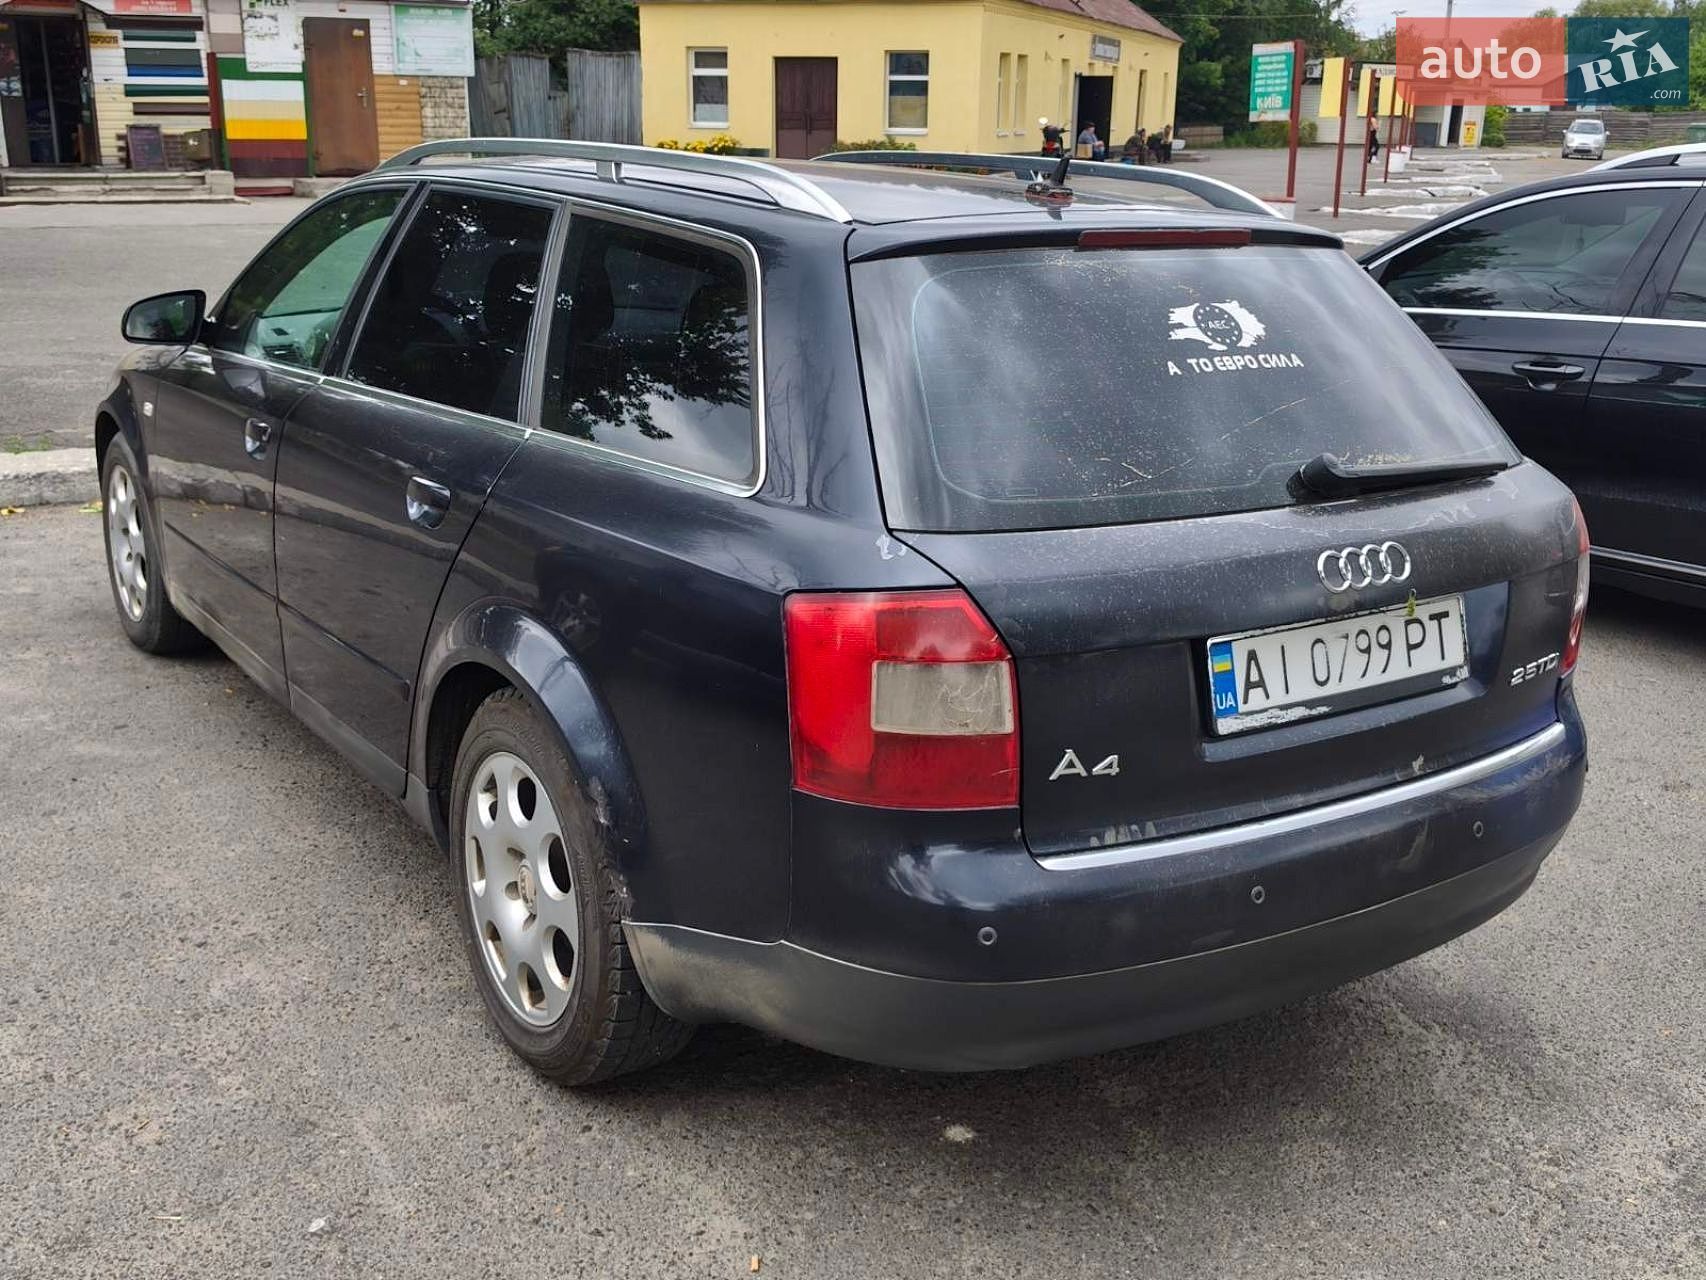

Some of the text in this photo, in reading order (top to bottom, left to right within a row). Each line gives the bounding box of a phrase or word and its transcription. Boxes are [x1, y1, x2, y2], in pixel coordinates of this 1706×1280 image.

[1311, 624, 1392, 687] 0799
[1216, 691, 1236, 710] UA
[1048, 749, 1120, 780] A4
